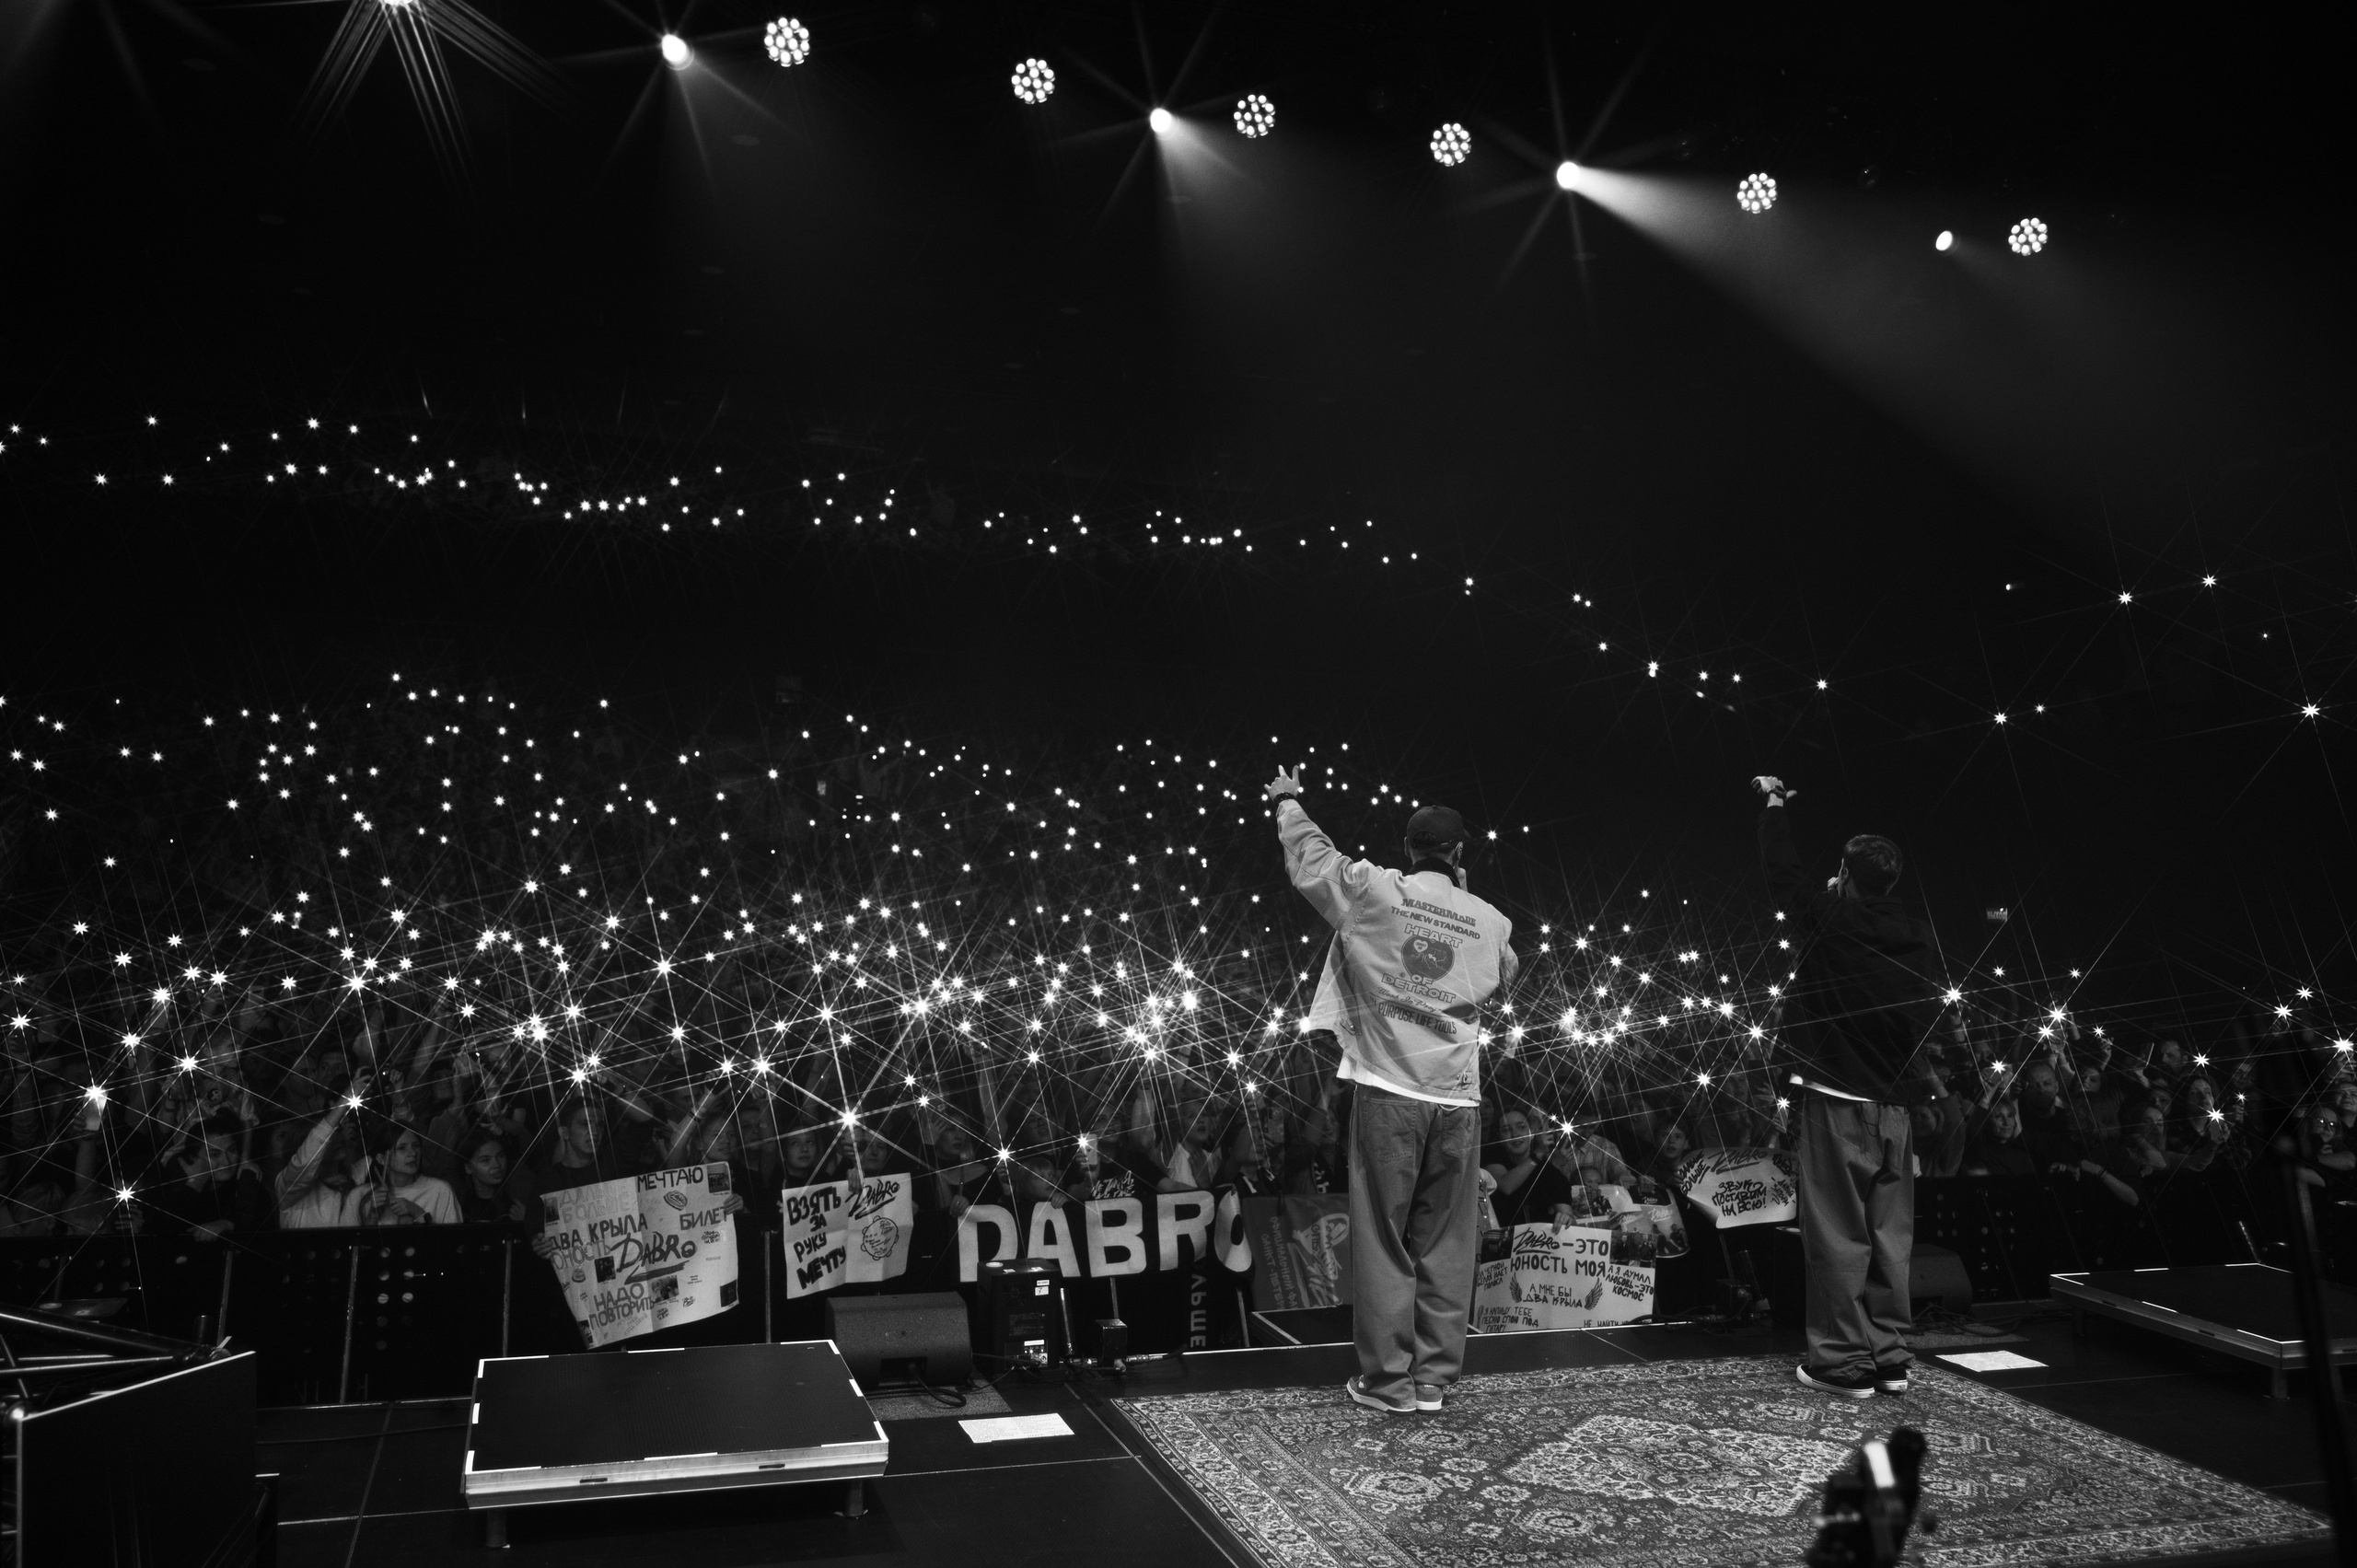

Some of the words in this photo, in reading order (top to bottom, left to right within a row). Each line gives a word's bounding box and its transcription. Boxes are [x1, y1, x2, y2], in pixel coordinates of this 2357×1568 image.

[1390, 906, 1410, 918] THE
[1410, 912, 1434, 924] NEW
[1433, 919, 1480, 940] STANDARD
[1404, 923, 1464, 949] HEART
[1381, 972, 1457, 1004] DETROIT
[1411, 973, 1434, 986] OF
[1378, 1002, 1414, 1023] PURPOSE
[1415, 1013, 1434, 1028] LIFE
[1434, 1018, 1457, 1034] TOOLS
[637, 1167, 703, 1192] МЕЧТАЮ
[786, 1185, 842, 1225] ВЗЯТЬ
[1722, 1202, 1736, 1216] НА
[1737, 1197, 1767, 1214] ВСЮ!
[588, 1213, 647, 1242] КРЫЛА
[809, 1214, 828, 1232] ЗА
[958, 1182, 1252, 1283] DABRO
[793, 1232, 827, 1263] РУКУ
[1575, 1238, 1608, 1256] ЭТО
[796, 1246, 846, 1290] МЕЧТУ
[1261, 1233, 1285, 1310] САНКТ-ПЕТЕР
[1270, 1216, 1295, 1290] ОФИЦИАЛЬНЫЙ
[1286, 1291, 1298, 1308] ФА
[1510, 1254, 1568, 1274] ЮНОСТЬ
[1575, 1259, 1606, 1278] МОЯ
[1605, 1273, 1633, 1289] ЛЮБОВЬ
[1615, 1266, 1620, 1275] Я
[1623, 1269, 1651, 1284] ДУМАЛ
[594, 1283, 644, 1311] НАДО
[1522, 1293, 1549, 1304] ДВА
[1552, 1295, 1583, 1307] КРЫЛА
[1529, 1283, 1537, 1294] А
[1538, 1283, 1555, 1296] МНЕ
[1558, 1285, 1572, 1297] БЫ
[1612, 1284, 1644, 1302] КОСМОС
[588, 1296, 655, 1330] ПОВТОРИТЬ
[1515, 1307, 1534, 1317] ТЕБЕ
[1521, 1317, 1538, 1328] ПОД
